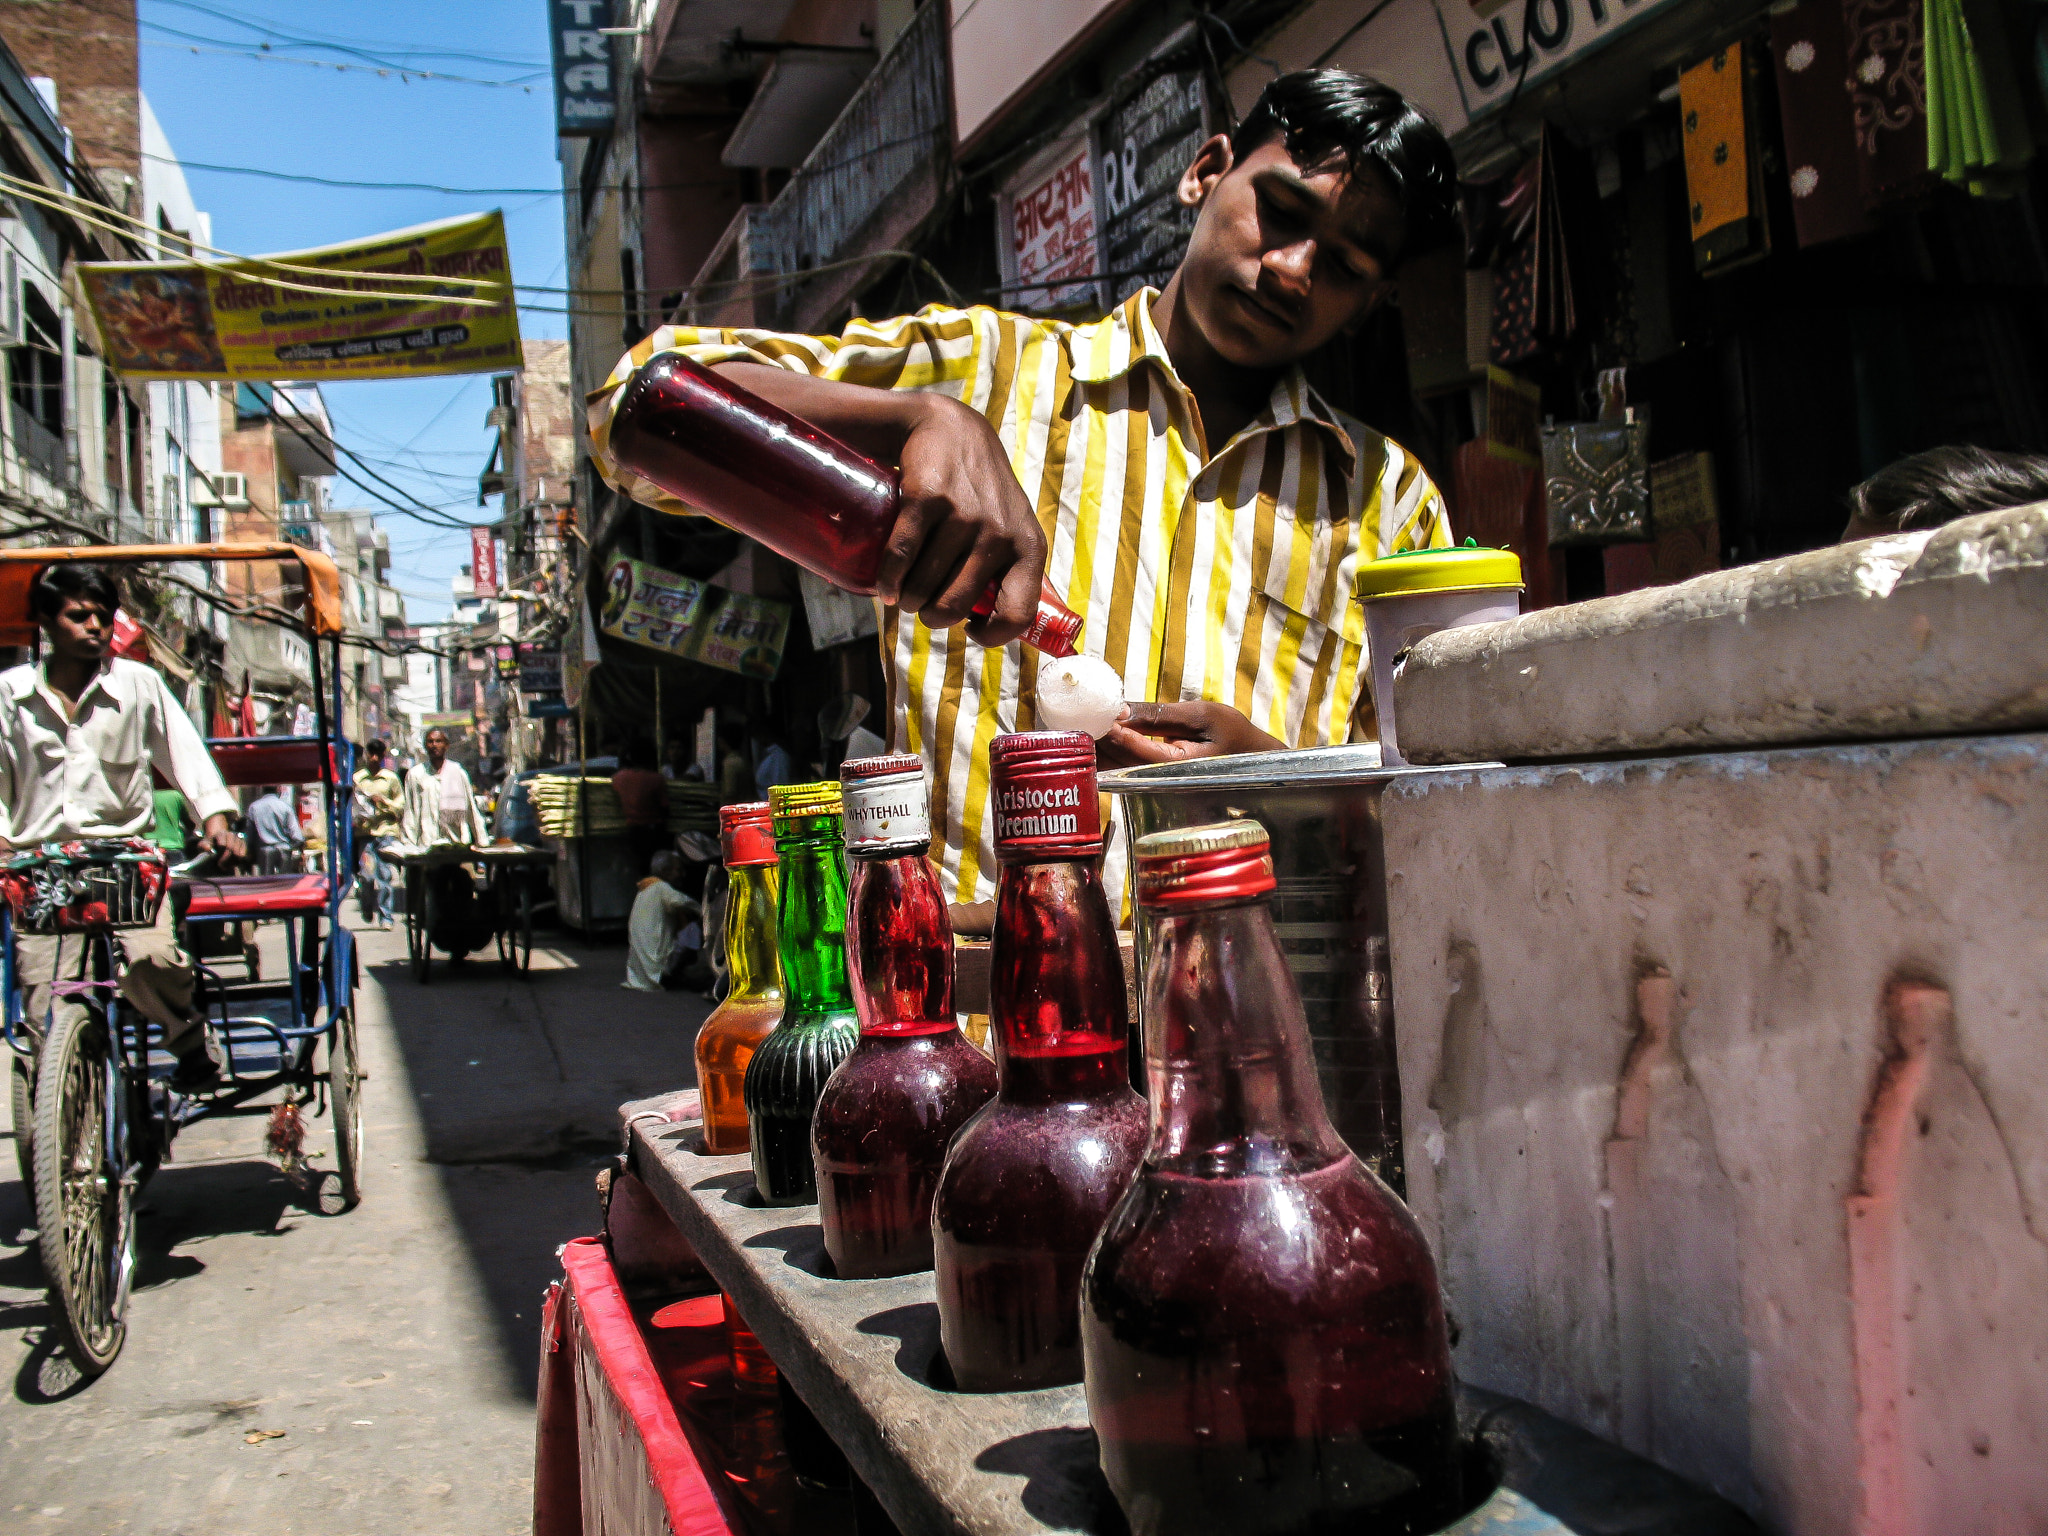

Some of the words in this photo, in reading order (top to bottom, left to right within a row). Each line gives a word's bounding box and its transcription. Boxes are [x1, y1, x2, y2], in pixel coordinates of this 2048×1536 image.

[1465, 0, 1634, 89] CLO
[847, 803, 912, 822] WHYTEHALL
[998, 808, 1078, 837] Premium
